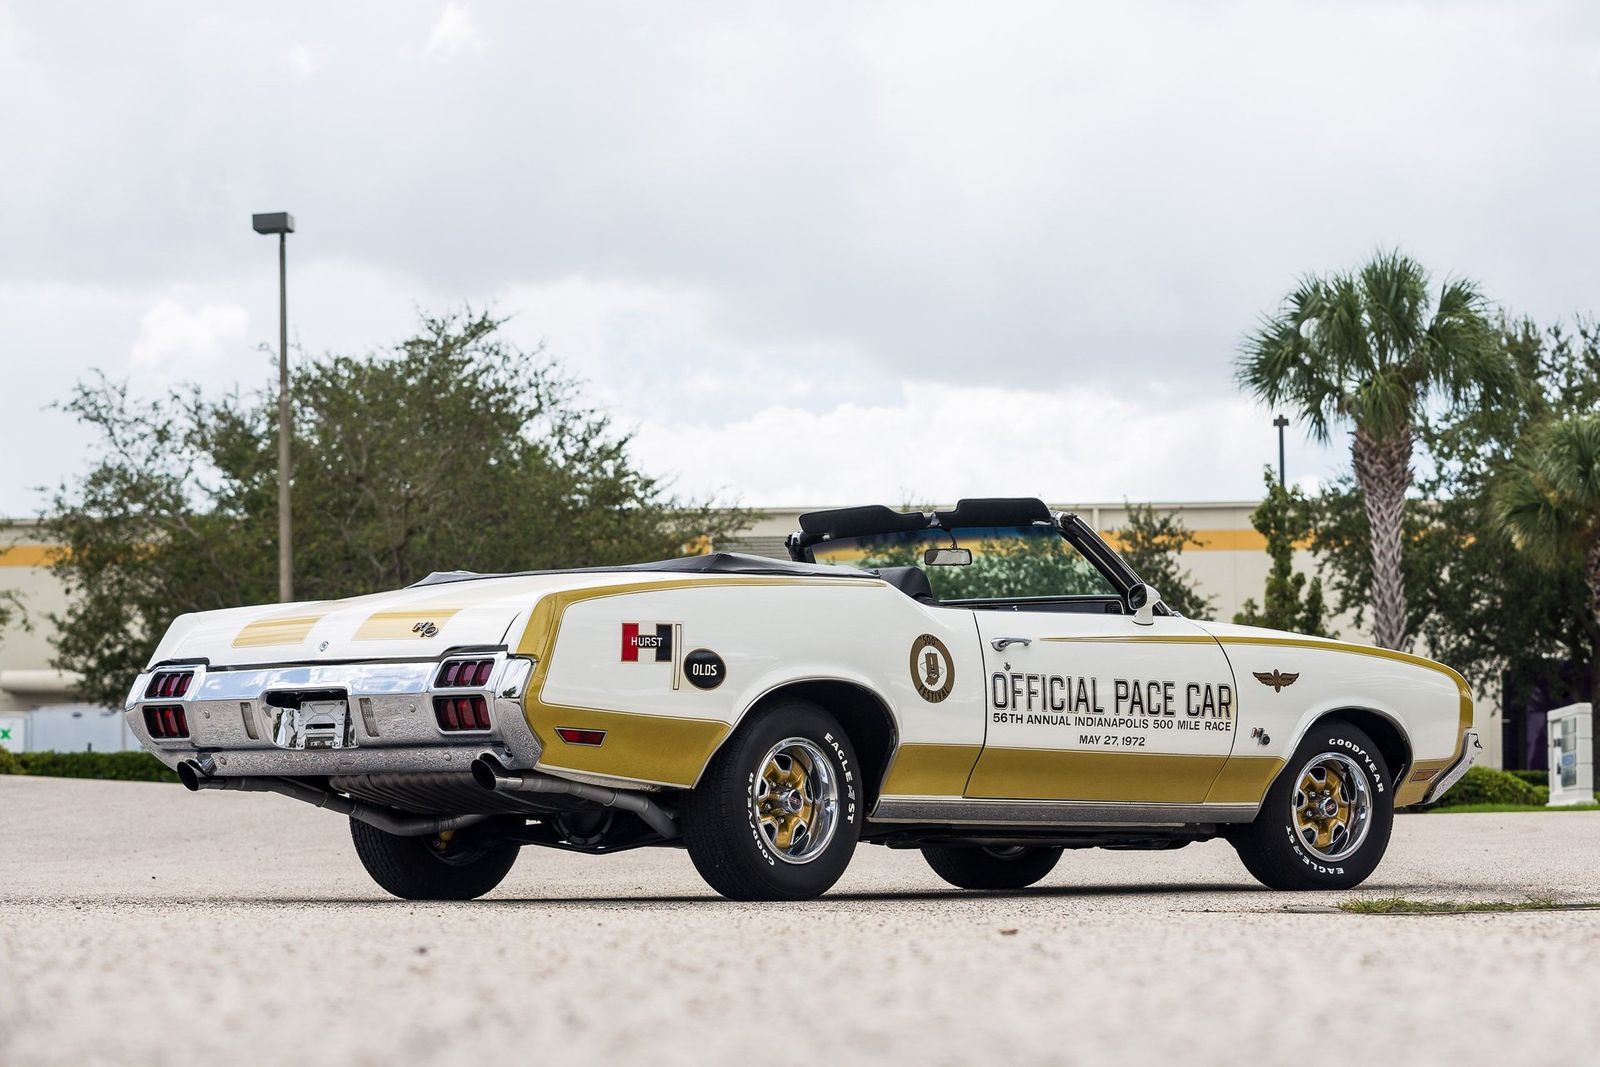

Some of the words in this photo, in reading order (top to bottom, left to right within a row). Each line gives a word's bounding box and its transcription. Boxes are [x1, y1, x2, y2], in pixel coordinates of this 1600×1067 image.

[631, 636, 663, 647] HURST
[692, 663, 718, 676] OLDS
[919, 684, 950, 702] FESTIVAL
[991, 672, 1105, 715] OFFICIAL
[1114, 678, 1176, 718] PACE
[1186, 682, 1231, 720] CAR
[993, 713, 1024, 724] 56TH
[1026, 714, 1071, 726] ANNUAL
[1074, 716, 1149, 729] INDIANAPOLIS
[1153, 719, 1174, 730] 500
[1177, 720, 1200, 731] MILE
[1204, 721, 1231, 732] RACE
[1079, 735, 1101, 745] MAY
[1122, 736, 1145, 747] 1972
[1328, 738, 1384, 793] GOODYEAR
[824, 732, 854, 783] EAGLE
[847, 803, 856, 824] ST
[1285, 825, 1295, 844] ST
[1302, 855, 1345, 875] EAGLE
